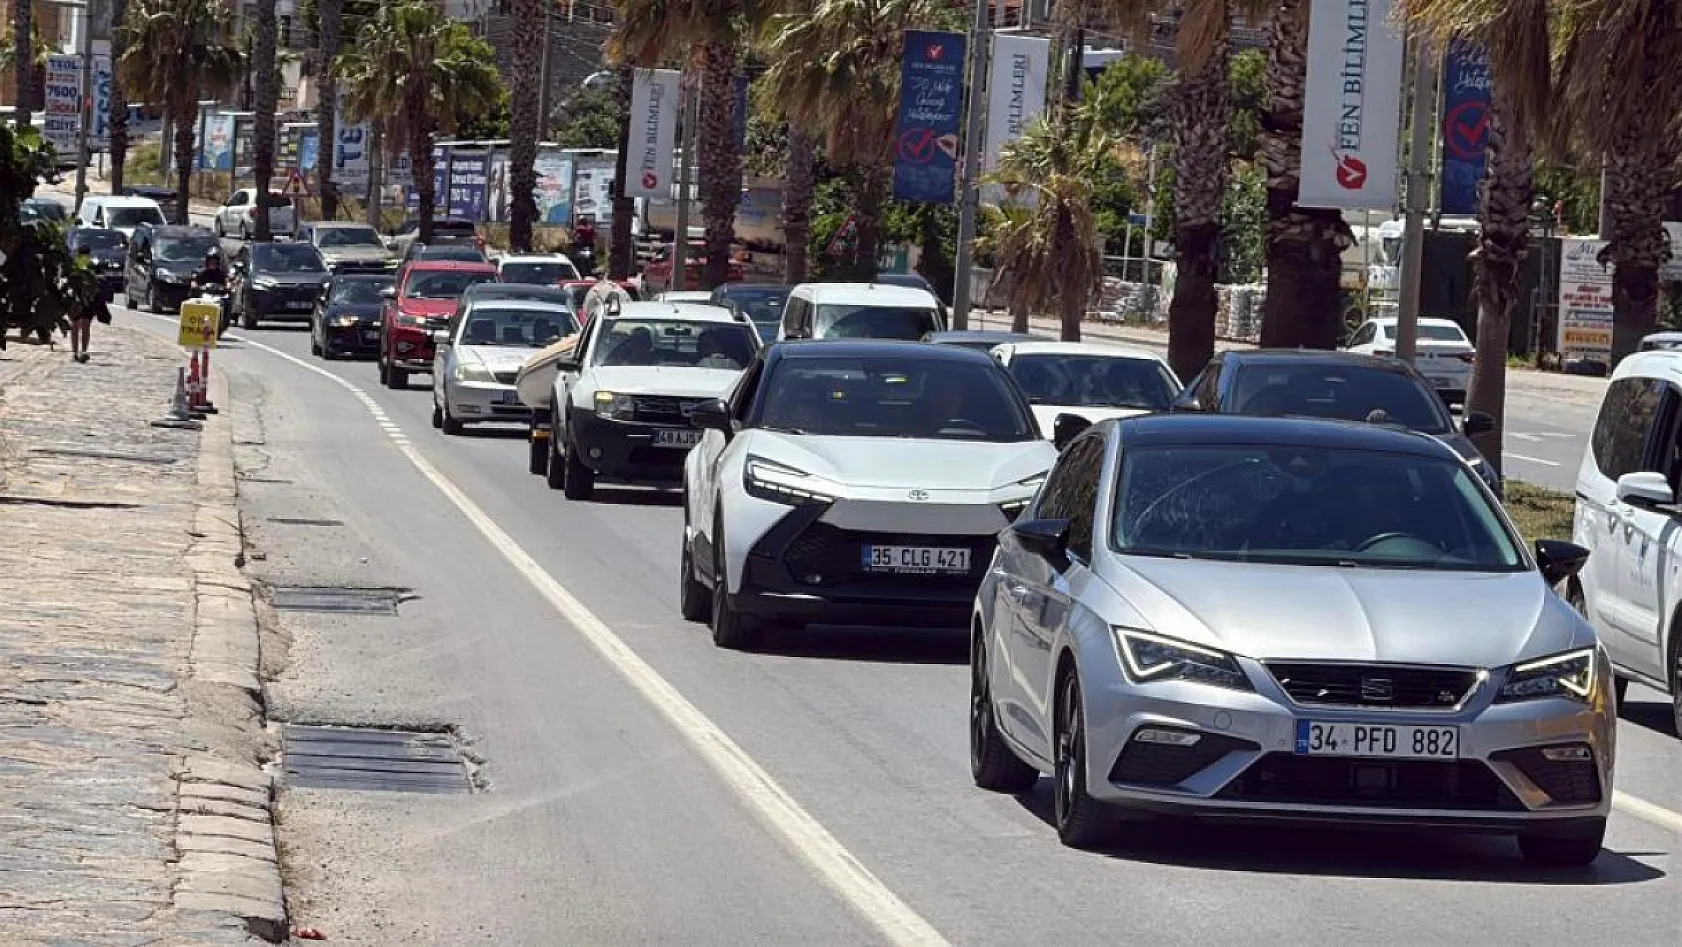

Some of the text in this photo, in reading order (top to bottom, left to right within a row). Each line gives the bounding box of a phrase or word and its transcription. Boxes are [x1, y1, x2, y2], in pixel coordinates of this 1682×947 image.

[1340, 104, 1361, 150] FEN
[872, 548, 965, 567] 35 CLG 421
[1311, 725, 1337, 751] 34
[1354, 727, 1397, 753] PFD
[1412, 728, 1454, 755] 882
